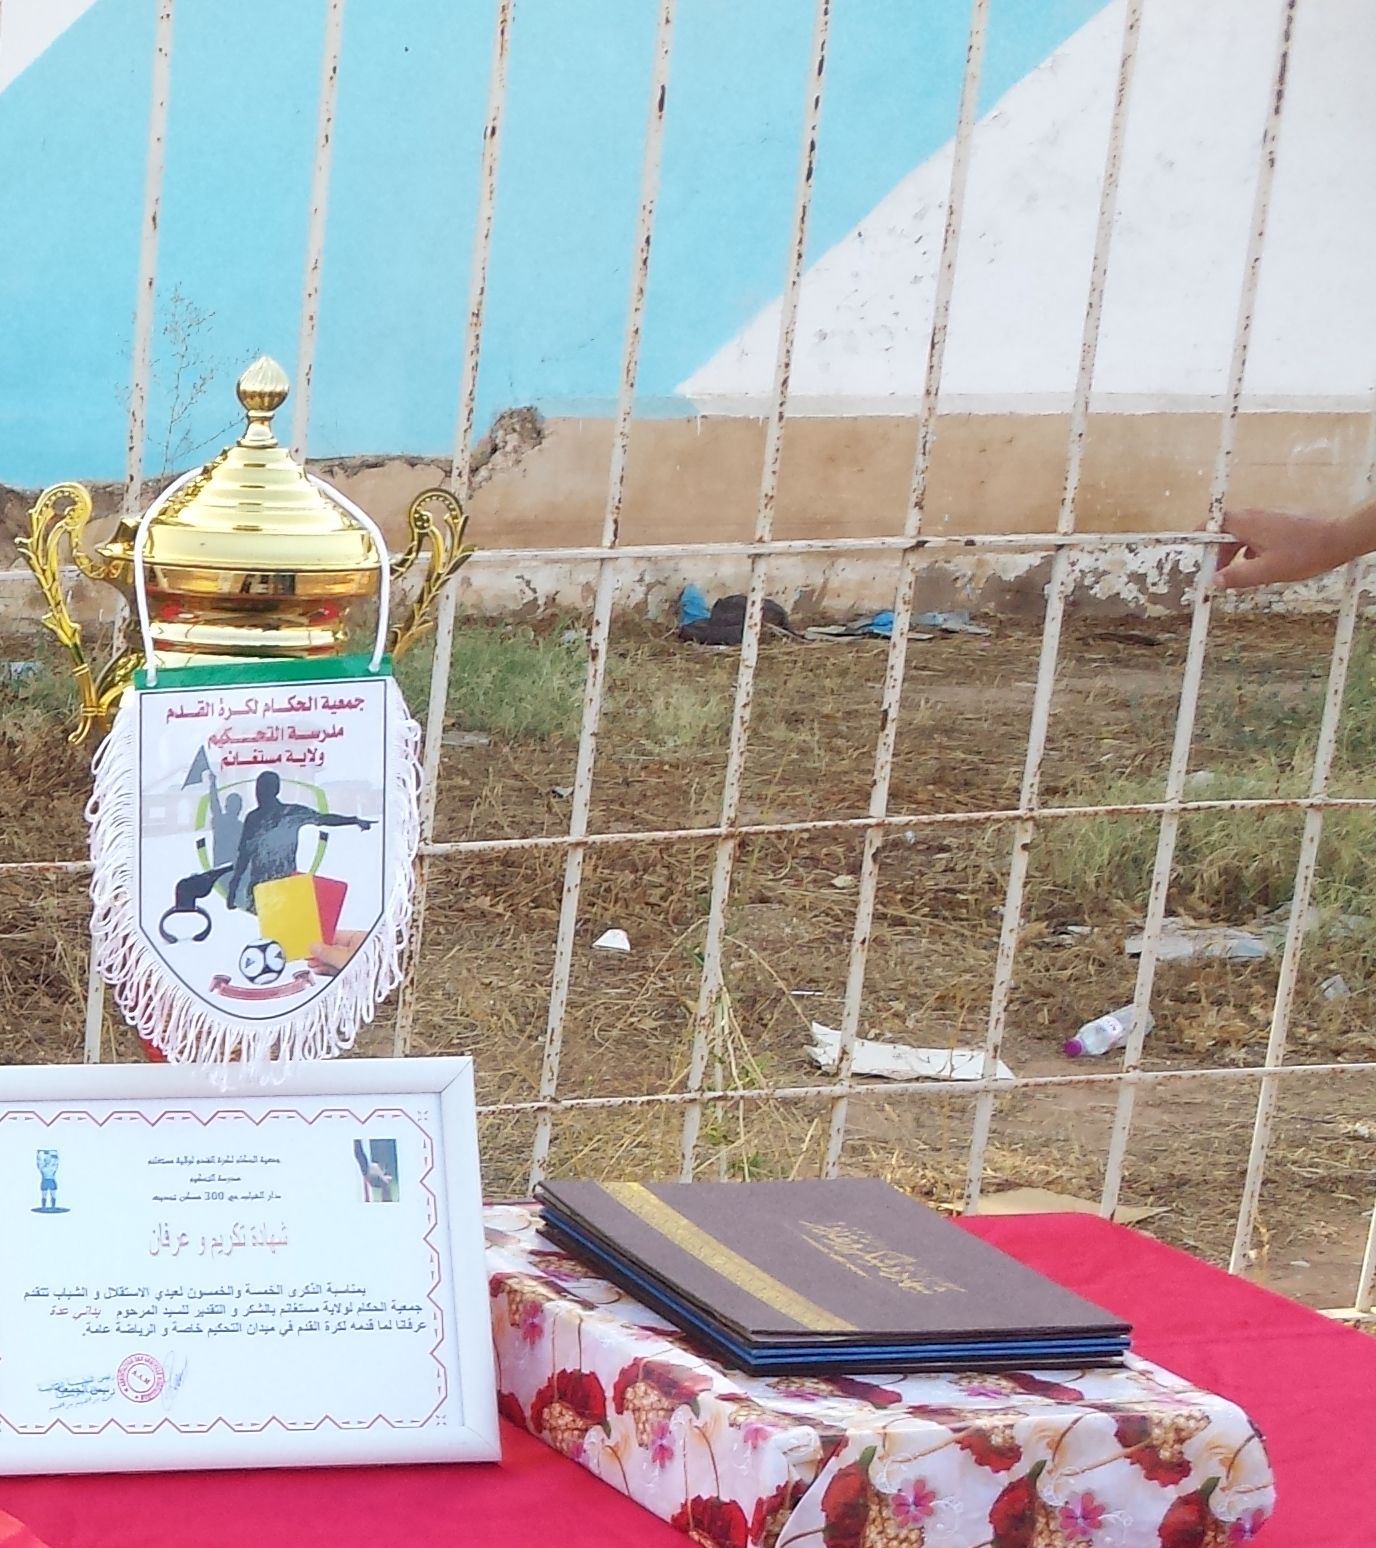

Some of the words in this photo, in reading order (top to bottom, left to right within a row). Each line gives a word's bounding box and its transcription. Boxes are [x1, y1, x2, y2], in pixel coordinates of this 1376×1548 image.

[166, 700, 214, 724] القدم
[262, 695, 318, 719] الحكام
[321, 695, 365, 715] جمعية
[207, 726, 284, 749] التحكيم
[288, 724, 344, 743] مدرسة
[220, 748, 282, 770] مستغانم
[286, 748, 325, 768] ولاية
[204, 1191, 224, 1201] 300
[149, 1221, 190, 1257] عرفان
[211, 1221, 246, 1260] تكريم
[250, 1221, 288, 1255] شهادة
[197, 1236, 206, 1256] و
[24, 1286, 50, 1302] تتقدم
[53, 1285, 88, 1300] الشباب
[93, 1289, 100, 1300] و
[103, 1286, 150, 1300] الاستقلال
[154, 1285, 184, 1302] لعيدي
[187, 1284, 242, 1299] والخمسون
[246, 1283, 283, 1296] الخمسة
[326, 1282, 366, 1297] بمناسبة
[116, 1304, 158, 1319] المرحوم
[162, 1304, 189, 1318] للسيد
[194, 1304, 226, 1318] التقدير
[230, 1306, 238, 1317] و
[242, 1302, 276, 1317] بالشكر
[279, 1302, 320, 1317] مستغانم
[322, 1300, 353, 1316] لولاية
[356, 1301, 387, 1314] الحكام
[390, 1299, 423, 1313] جمعية
[115, 1322, 157, 1337] الرياضة
[161, 1325, 169, 1337] و
[171, 1322, 203, 1333] خاصة
[207, 1322, 242, 1338] التحكيم
[246, 1321, 276, 1336] ميدان
[279, 1320, 294, 1336] في
[297, 1321, 321, 1336] القدم
[324, 1320, 347, 1334] لكرة
[350, 1318, 374, 1331] قدمه
[377, 1319, 392, 1331] لما
